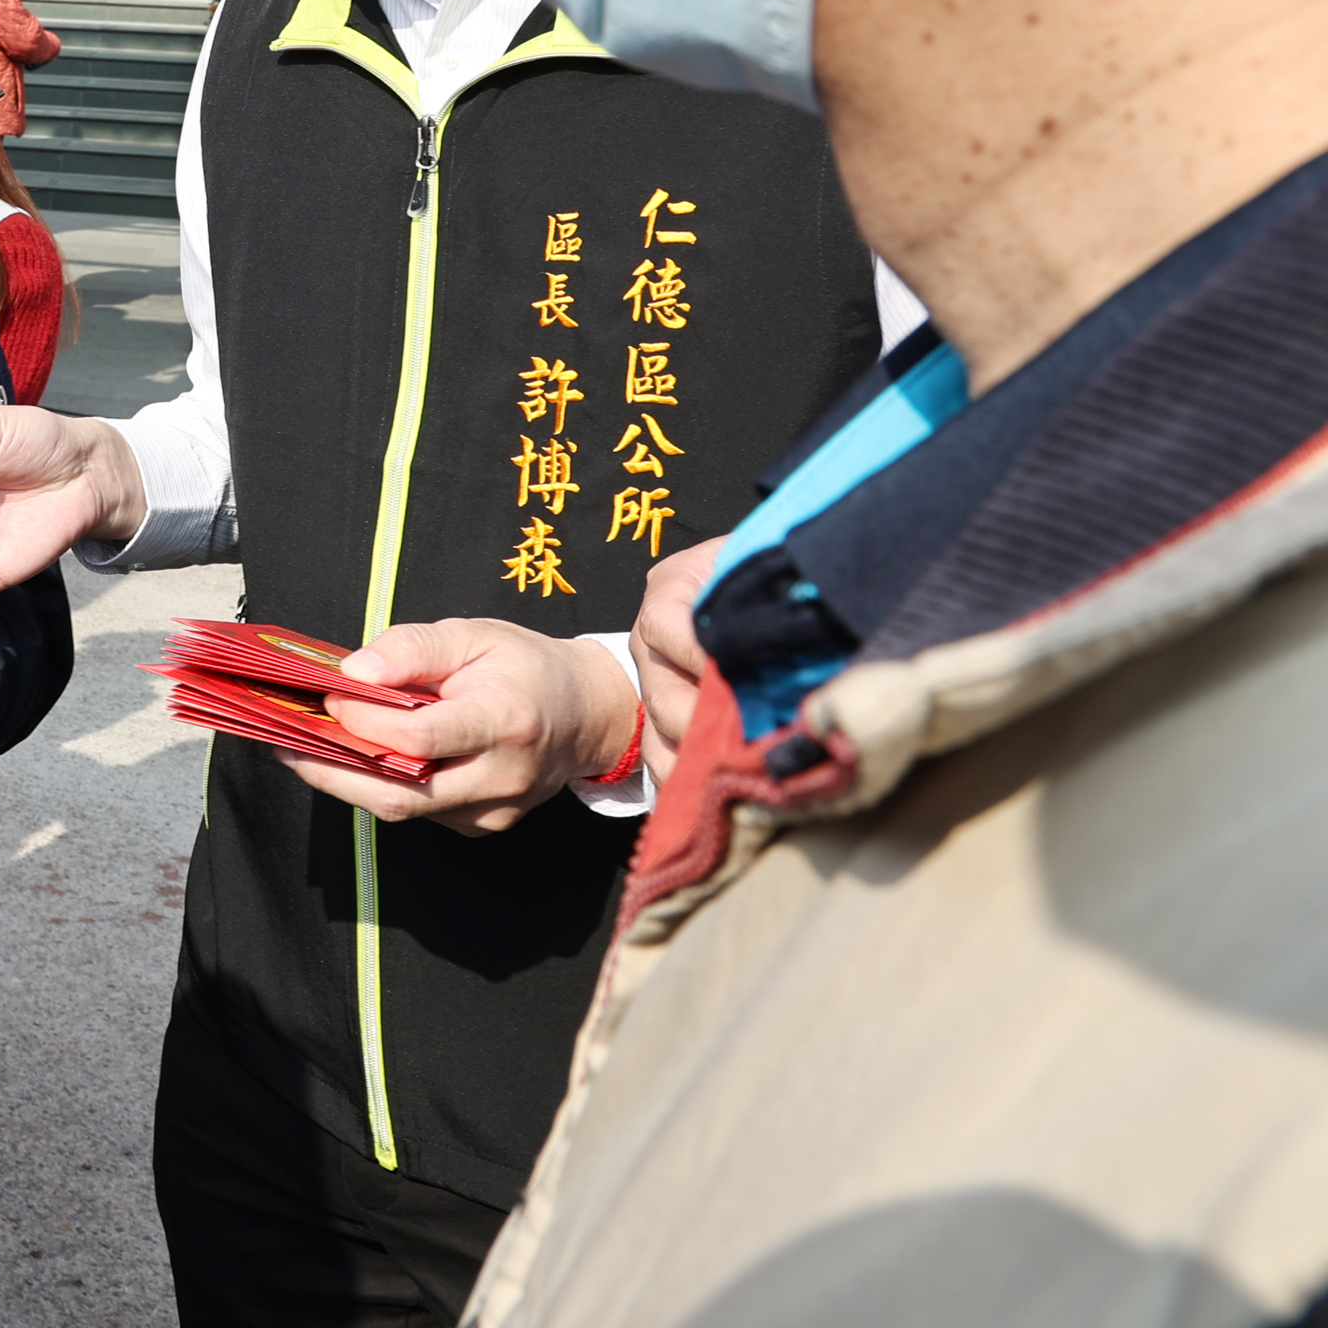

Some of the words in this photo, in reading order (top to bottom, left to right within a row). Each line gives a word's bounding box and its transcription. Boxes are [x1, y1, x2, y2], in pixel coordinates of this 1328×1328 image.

[531, 211, 584, 328] 區長
[605, 188, 697, 558] 仁德區公所
[500, 356, 585, 598] 許博森
